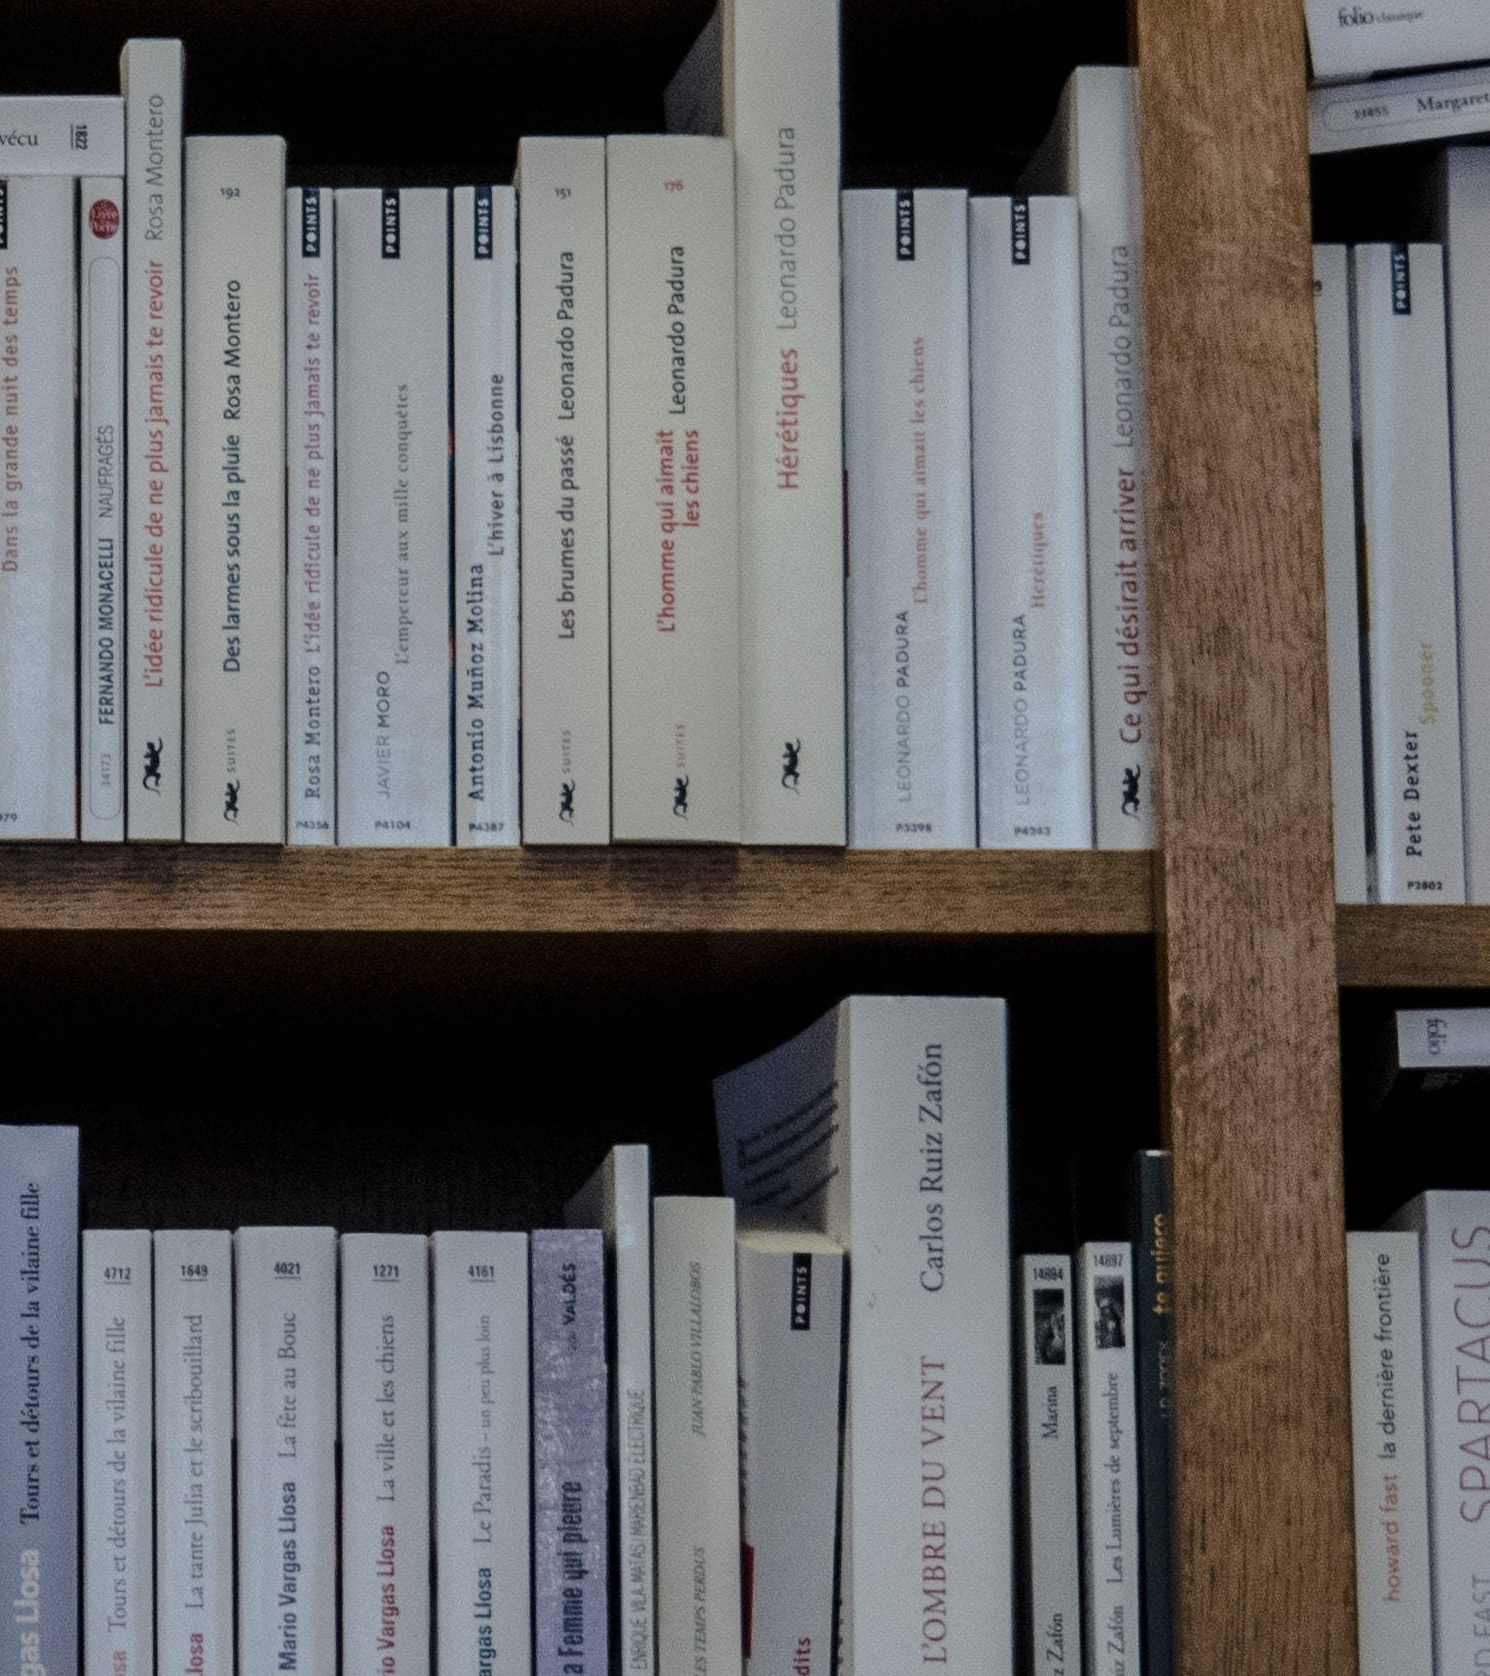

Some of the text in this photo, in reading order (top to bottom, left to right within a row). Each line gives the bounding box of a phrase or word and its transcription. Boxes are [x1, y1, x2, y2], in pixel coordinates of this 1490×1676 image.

[665, 246, 686, 416] Leonardo Padura
[655, 430, 682, 633] L'homme qui aimait
[679, 429, 700, 529] les chiens
[916, 1044, 948, 1665] L'OMBRE DU VENT Carlos Ruiz Zafón
[1372, 1253, 1397, 1460] la dernière frontière
